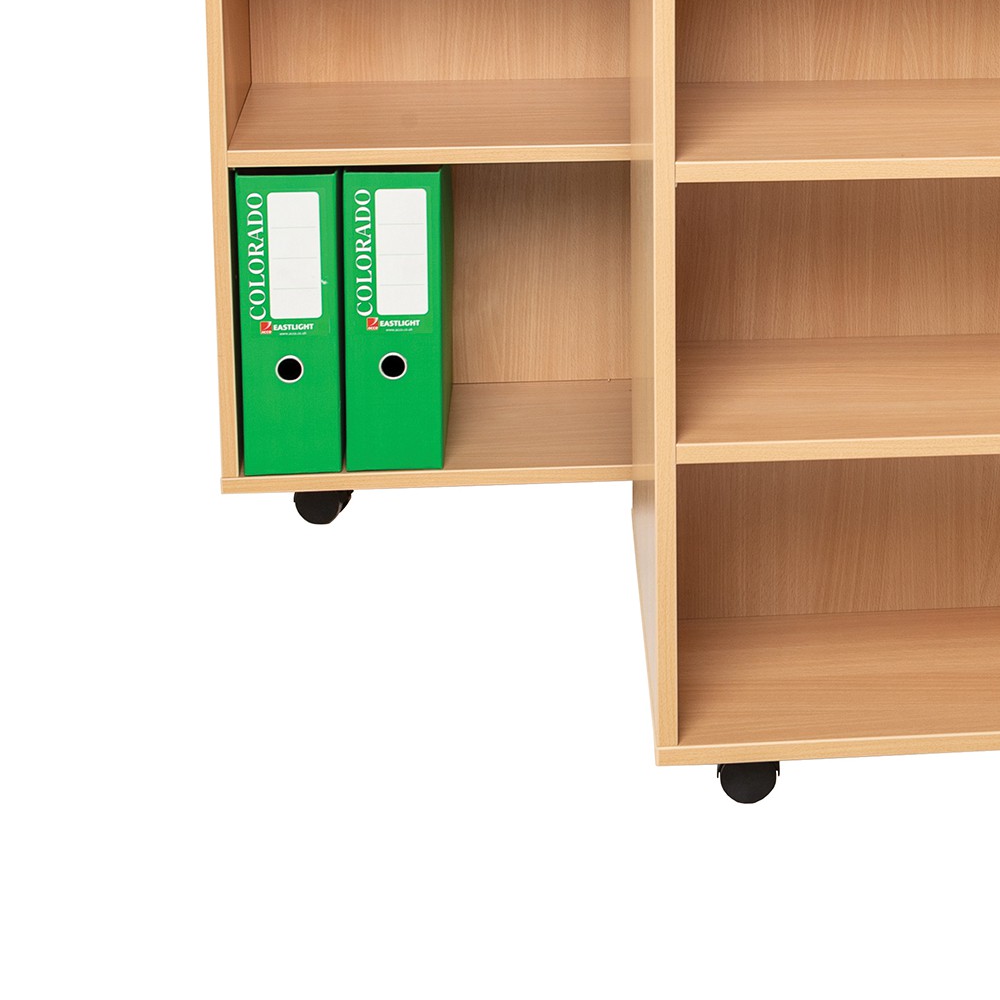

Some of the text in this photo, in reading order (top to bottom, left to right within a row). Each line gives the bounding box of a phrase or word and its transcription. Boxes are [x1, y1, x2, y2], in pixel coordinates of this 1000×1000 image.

[246, 192, 267, 321] COLORADO
[354, 189, 374, 317] COLORADO
[273, 323, 314, 331] EASTLIGHT
